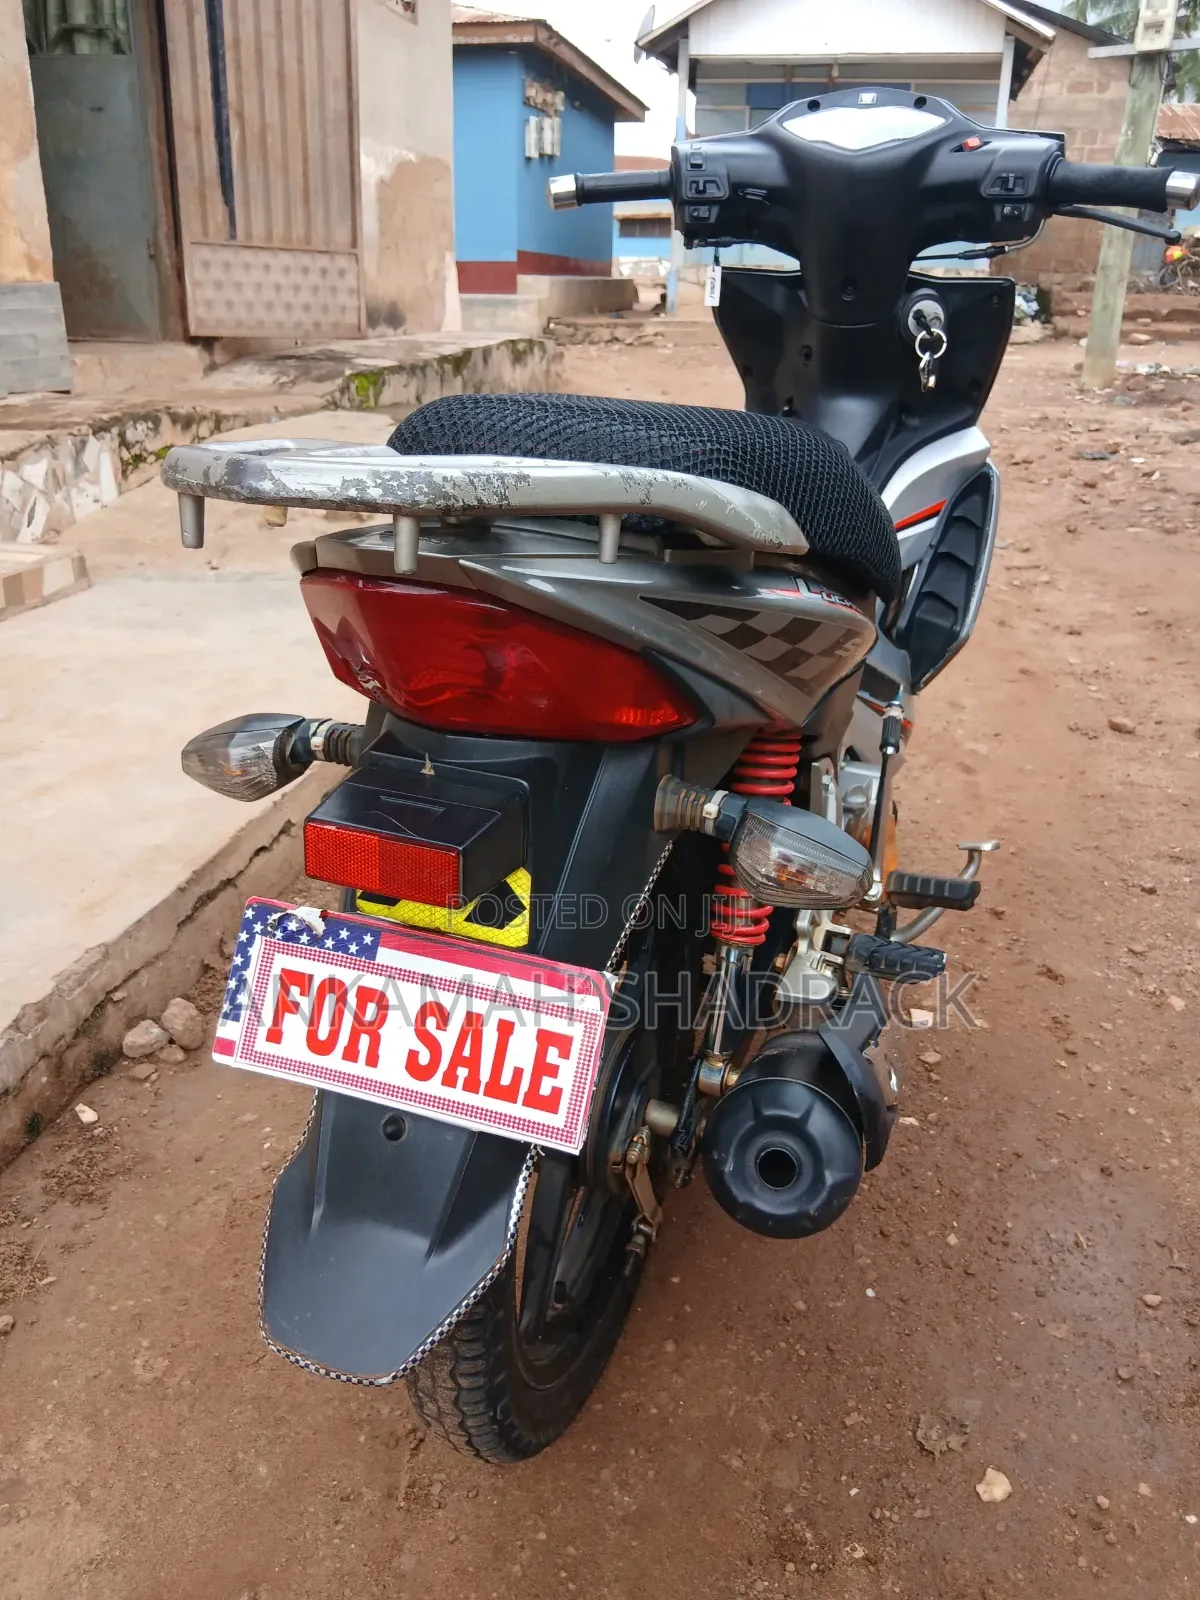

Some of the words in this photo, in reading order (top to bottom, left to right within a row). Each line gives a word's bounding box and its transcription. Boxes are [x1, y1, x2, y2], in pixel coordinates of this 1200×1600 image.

[795, 577, 864, 614] LUCK
[265, 968, 389, 1068] FOR
[404, 1001, 574, 1114] SALE
